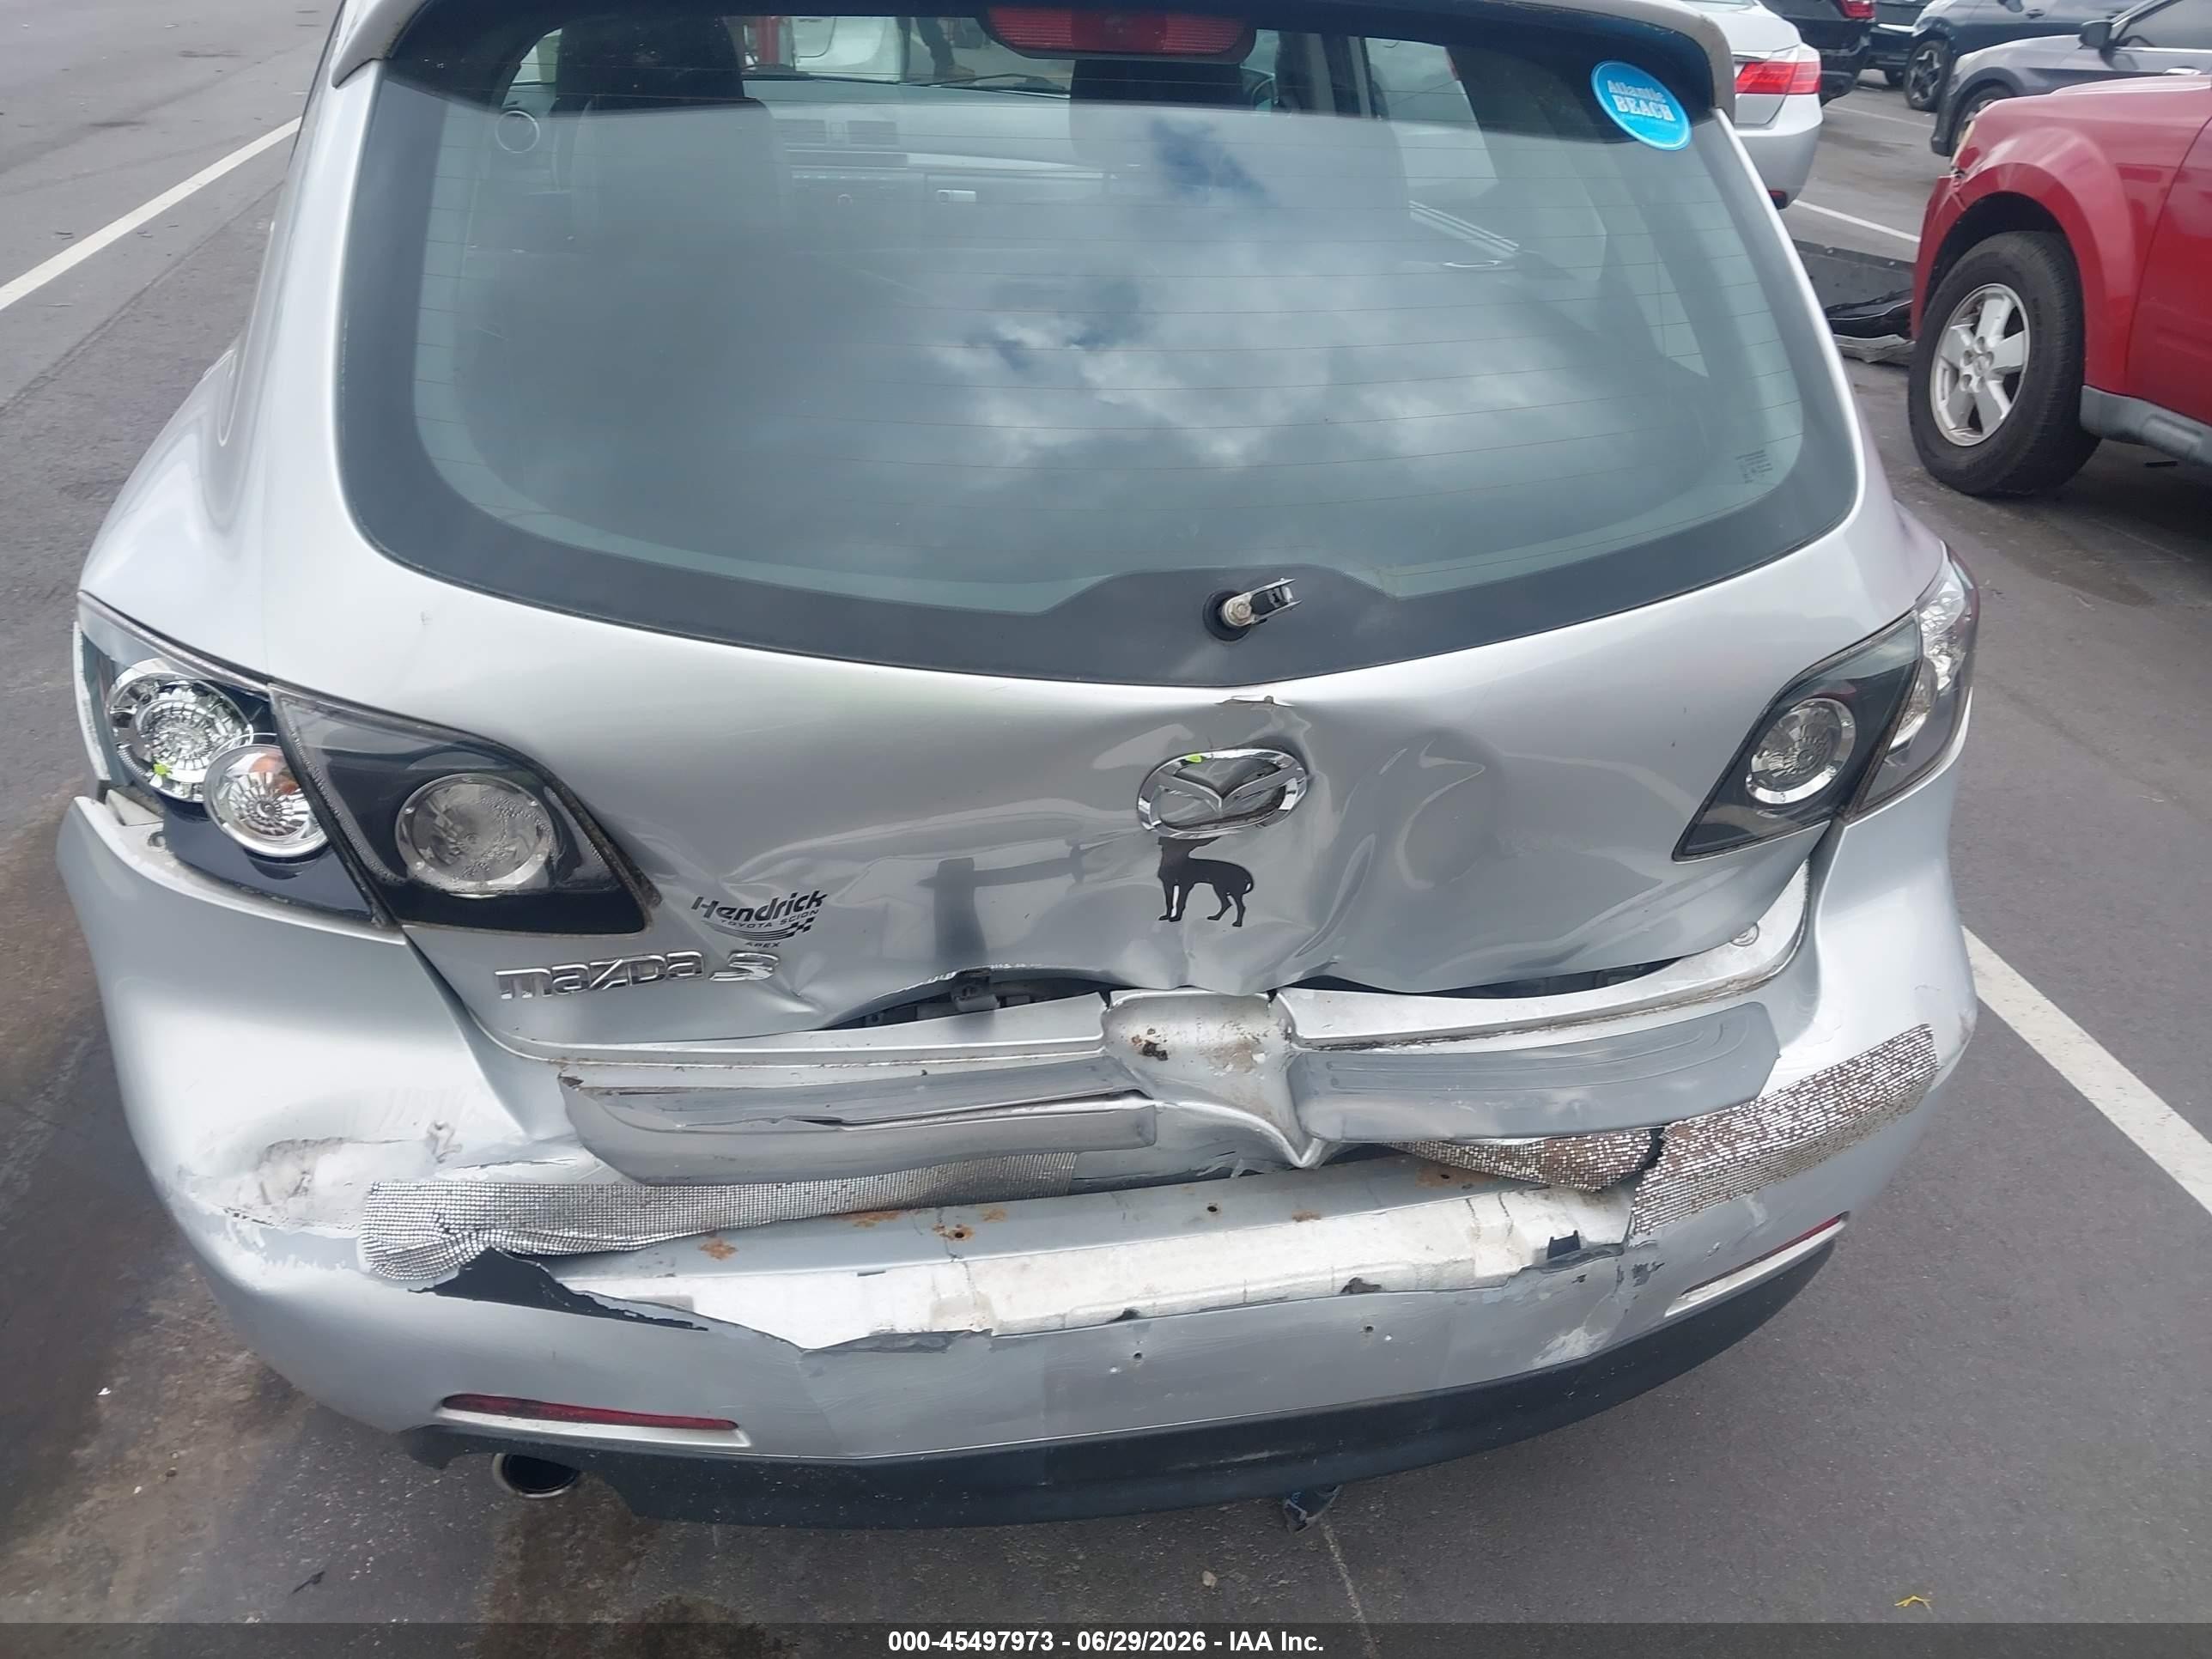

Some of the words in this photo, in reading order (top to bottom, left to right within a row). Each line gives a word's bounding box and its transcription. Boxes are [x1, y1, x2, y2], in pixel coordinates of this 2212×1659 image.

[1612, 94, 1676, 121] BEACH
[691, 890, 828, 922] Hendrick
[720, 919, 773, 928] TOYOTA
[780, 909, 819, 925] SCION
